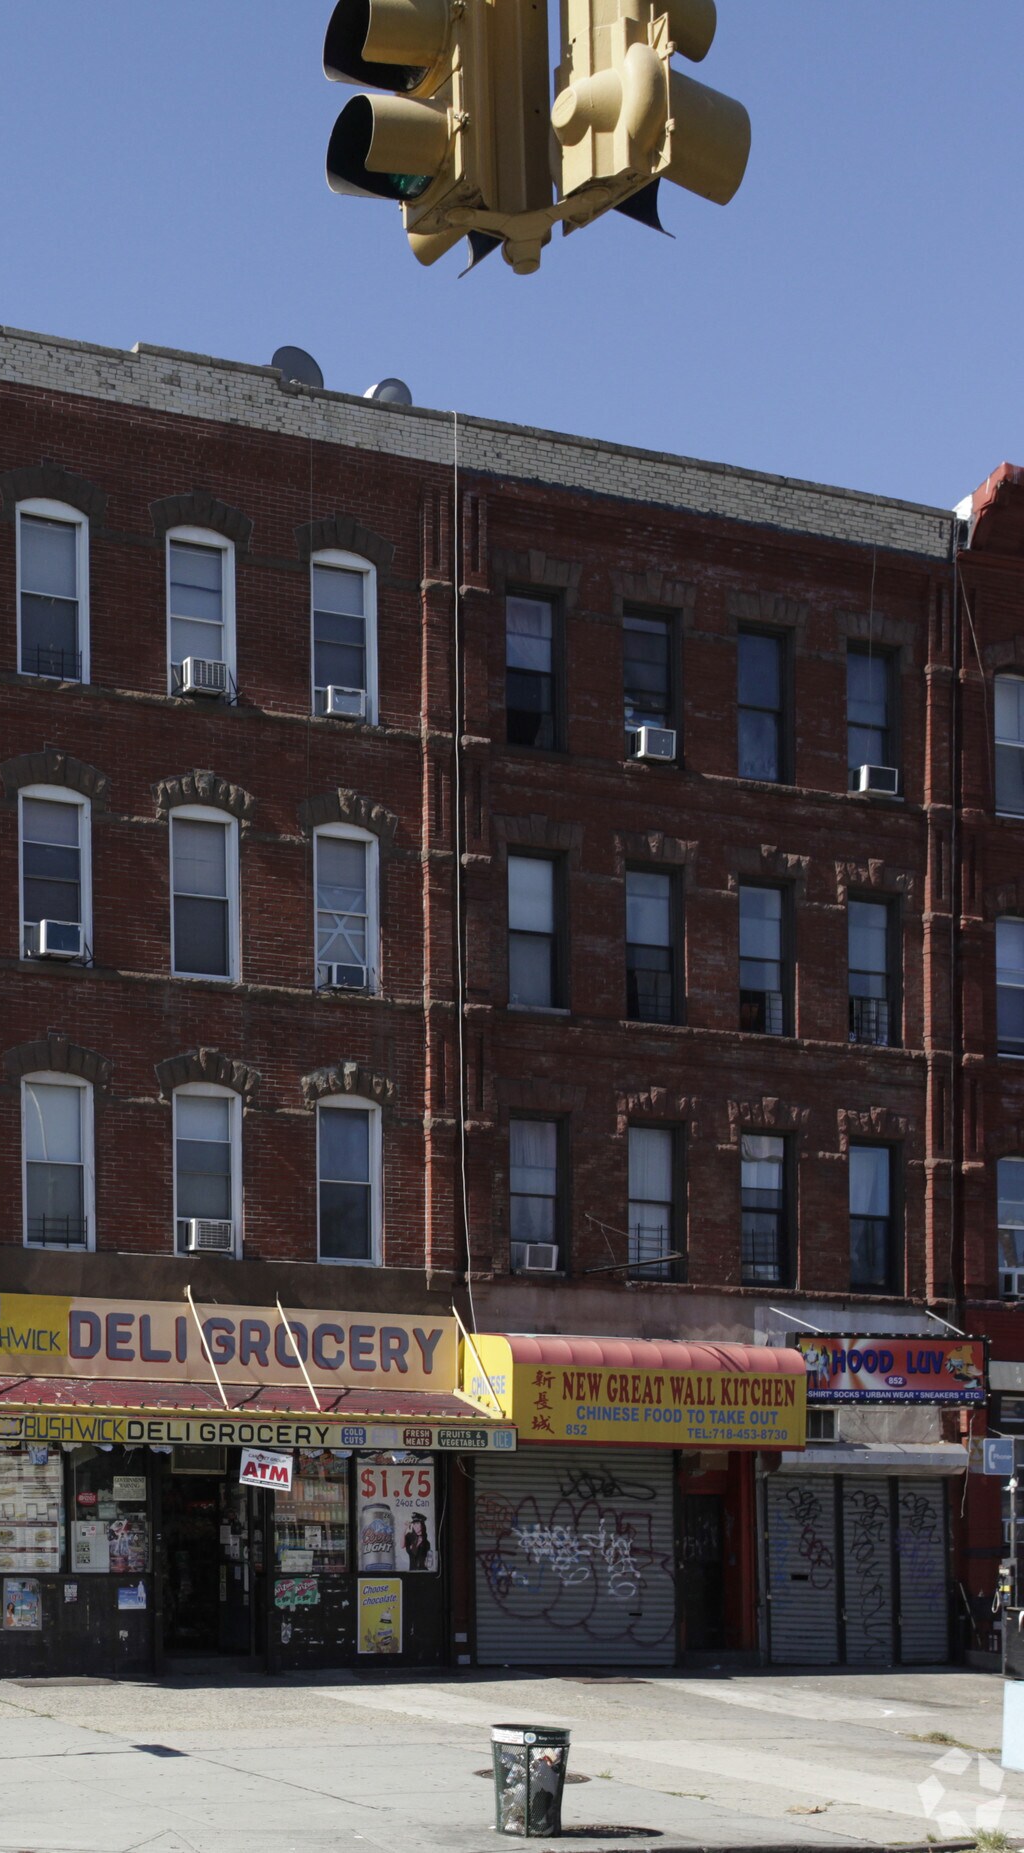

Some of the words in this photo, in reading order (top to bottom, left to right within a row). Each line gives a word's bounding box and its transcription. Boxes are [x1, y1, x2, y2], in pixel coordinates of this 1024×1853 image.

[69, 1310, 187, 1363] DELI
[201, 1317, 443, 1374] GROCERY
[832, 1350, 894, 1374] HOOD
[907, 1350, 944, 1374] LUV
[562, 1371, 603, 1402] NEW
[607, 1374, 665, 1404] GREAT
[669, 1376, 715, 1405] WALL
[720, 1377, 795, 1407] KITCHEN
[531, 1369, 556, 1434] 新長城
[576, 1405, 639, 1422] CHINESE
[644, 1408, 682, 1423] FOOD
[687, 1409, 705, 1424] TO
[709, 1410, 745, 1425] TAKE
[750, 1410, 778, 1425] OUT
[24, 1416, 124, 1440] BUSHWICK
[128, 1420, 190, 1441] DELI
[200, 1423, 329, 1444] GROCERY
[345, 1428, 363, 1436] COLD
[406, 1429, 430, 1437] FRESH
[566, 1424, 587, 1435] 852
[344, 1436, 364, 1445] CUTS
[406, 1438, 430, 1446] MEATS
[441, 1439, 485, 1447] VEGETABLES
[495, 1432, 508, 1447] ICE
[243, 1461, 288, 1483] ATM
[361, 1468, 431, 1498] $1.75
[396, 1499, 413, 1507] 24oz
[416, 1499, 429, 1507] Can
[363, 1543, 392, 1554] LIGHT
[363, 1585, 389, 1595] Choose
